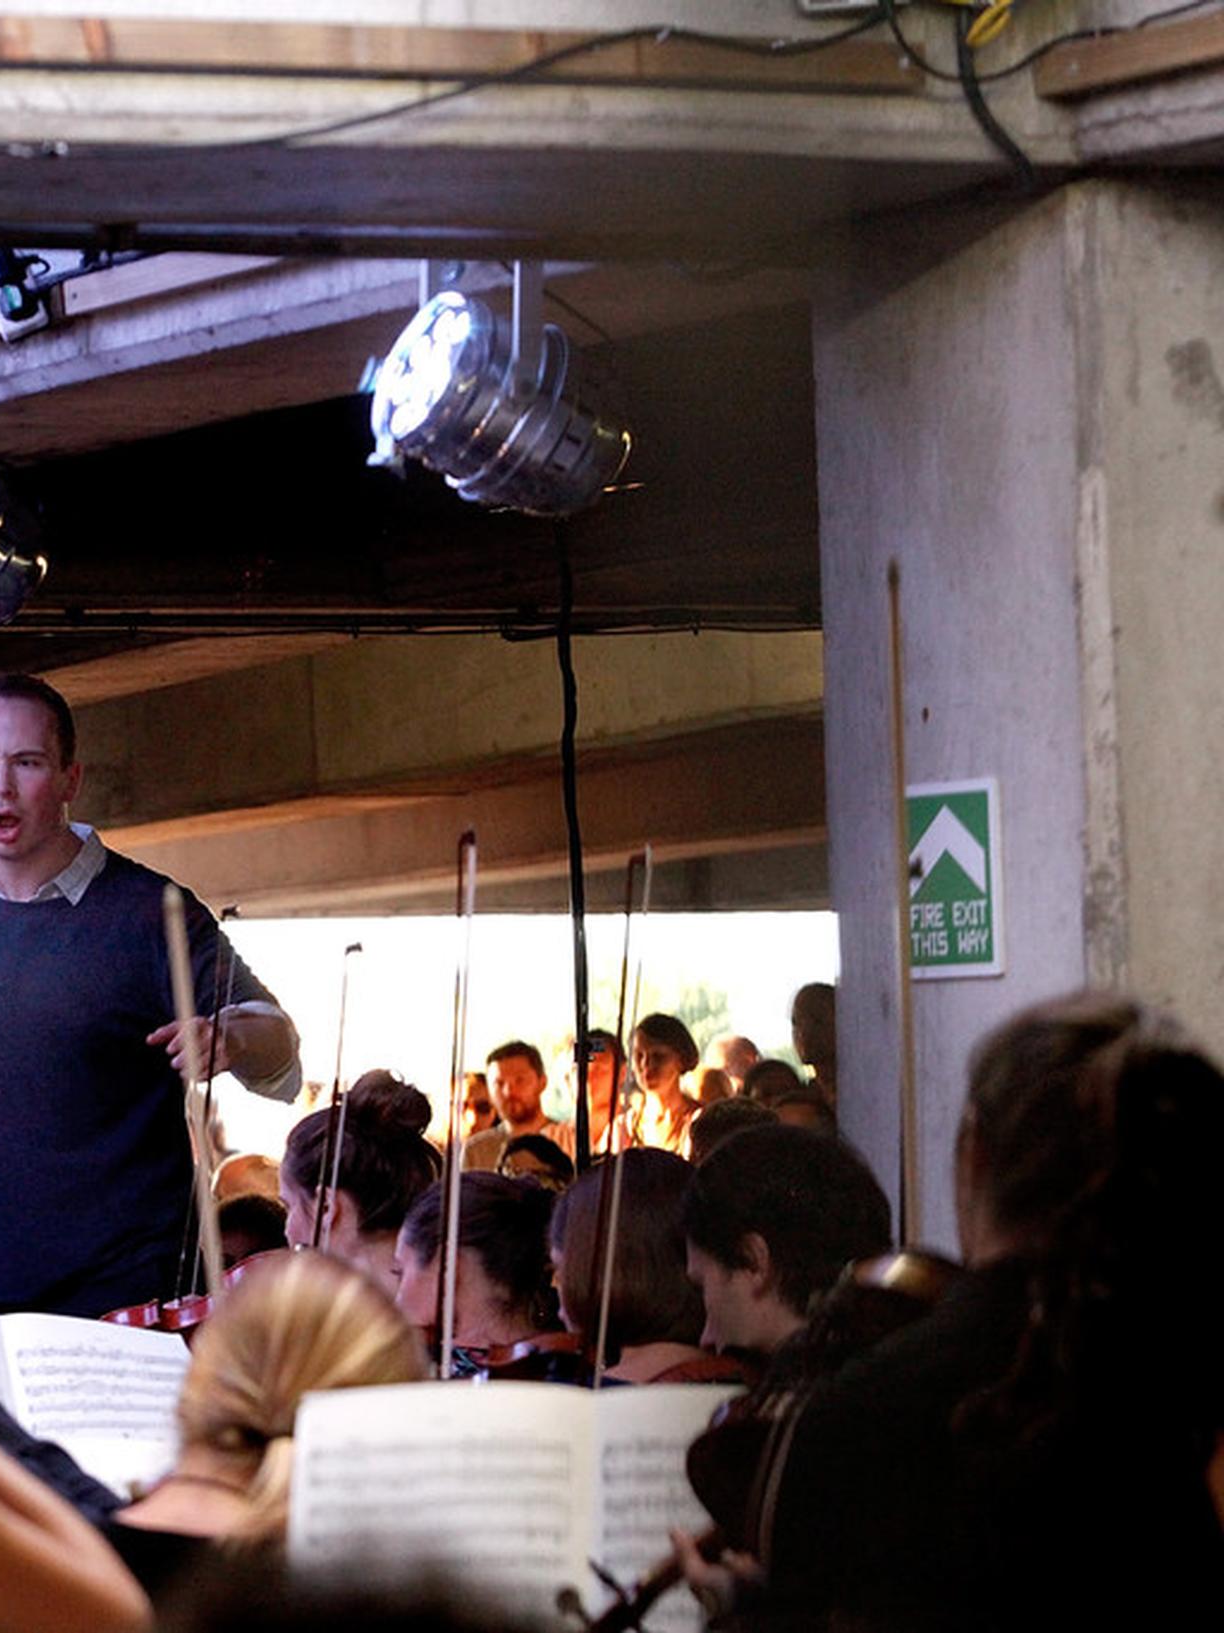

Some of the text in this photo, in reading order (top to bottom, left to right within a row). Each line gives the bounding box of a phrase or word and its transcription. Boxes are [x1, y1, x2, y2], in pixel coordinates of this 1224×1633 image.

[910, 900, 986, 929] FIRE EXIT
[911, 928, 989, 957] THIS WAY
